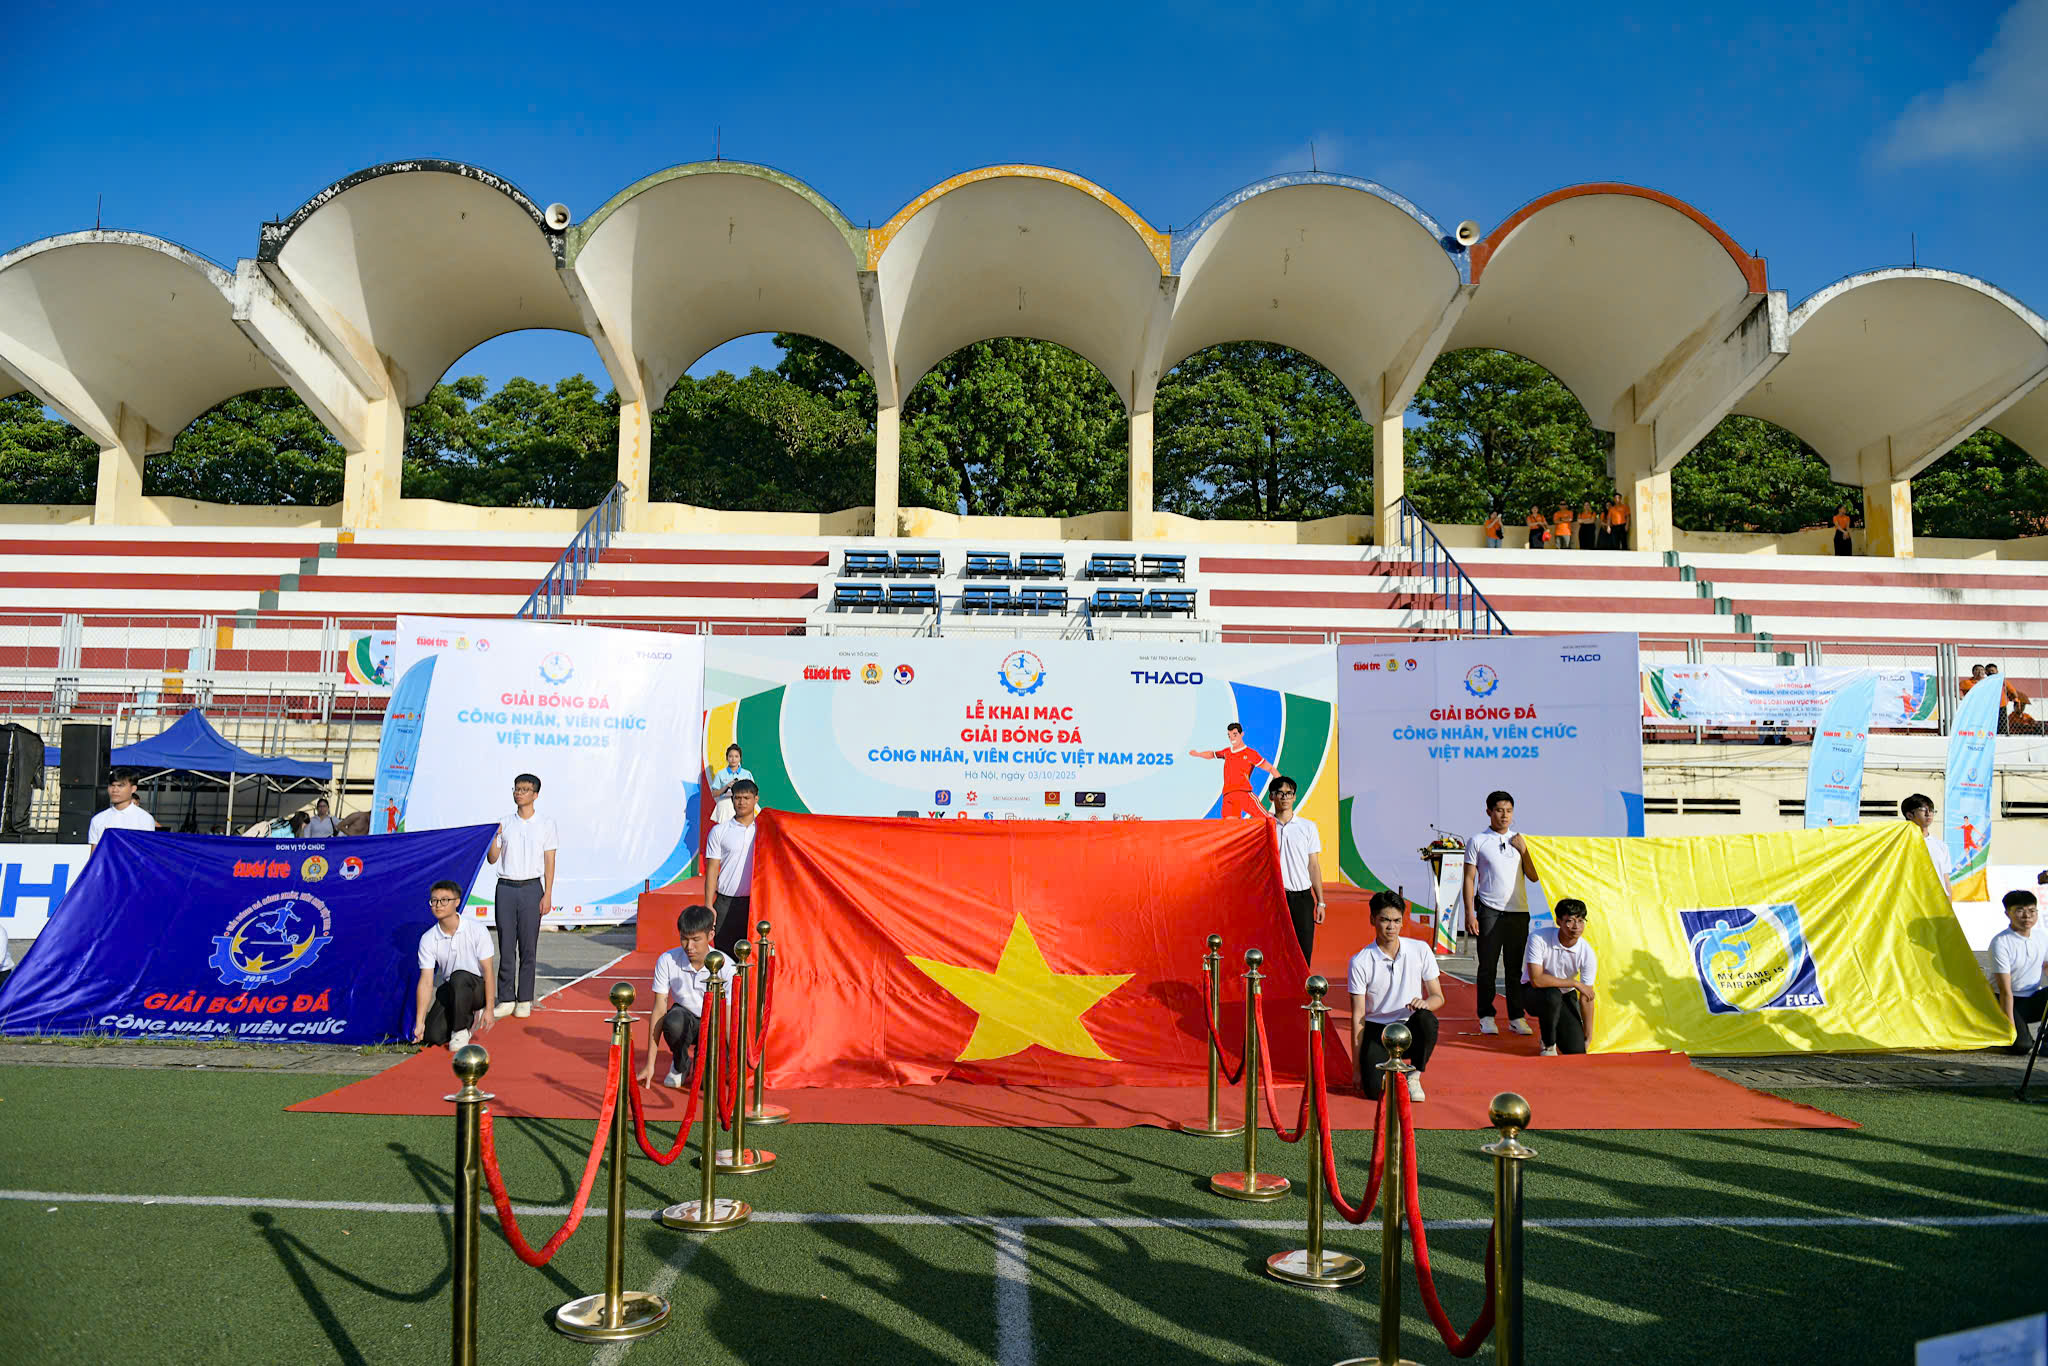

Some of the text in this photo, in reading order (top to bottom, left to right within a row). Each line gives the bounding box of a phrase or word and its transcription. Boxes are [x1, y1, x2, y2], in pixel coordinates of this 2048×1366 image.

[1560, 654, 1600, 662] THACO
[1131, 671, 1204, 684] THACO
[501, 690, 610, 710] GIẢI BÓNG ĐÁ
[457, 708, 646, 730] CÔNG NHÂN, VIÊN CHỨC
[966, 699, 1074, 724] LỄ KHAI MẠC
[1430, 704, 1536, 720] GIẢI BÓNG ĐÁ
[496, 729, 610, 748] VIỆT NAM 2025
[960, 724, 1082, 744] GIẢI BÓNG ĐÁ
[1392, 722, 1577, 742] CÔNG NHÂN, VIÊN CHỨC
[868, 746, 1174, 768] CÔNG NHÂN, VIÊN CHỨC VIỆT NAM 2025
[1428, 744, 1540, 762] VIỆT NAM 2025
[965, 770, 1076, 782] Hà Nội, ngày 03/10/2025
[243, 974, 268, 982] 2025
[1720, 976, 1773, 989] FAIR PLAY
[1738, 971, 1769, 979] GAME
[144, 988, 332, 1014] GIẢI BÓNG ĐÁ
[1786, 994, 1821, 1006] FIFA
[99, 1014, 167, 1032] CÔNG
[238, 1020, 284, 1034] VIÊN
[288, 1016, 348, 1035] CHỨC
